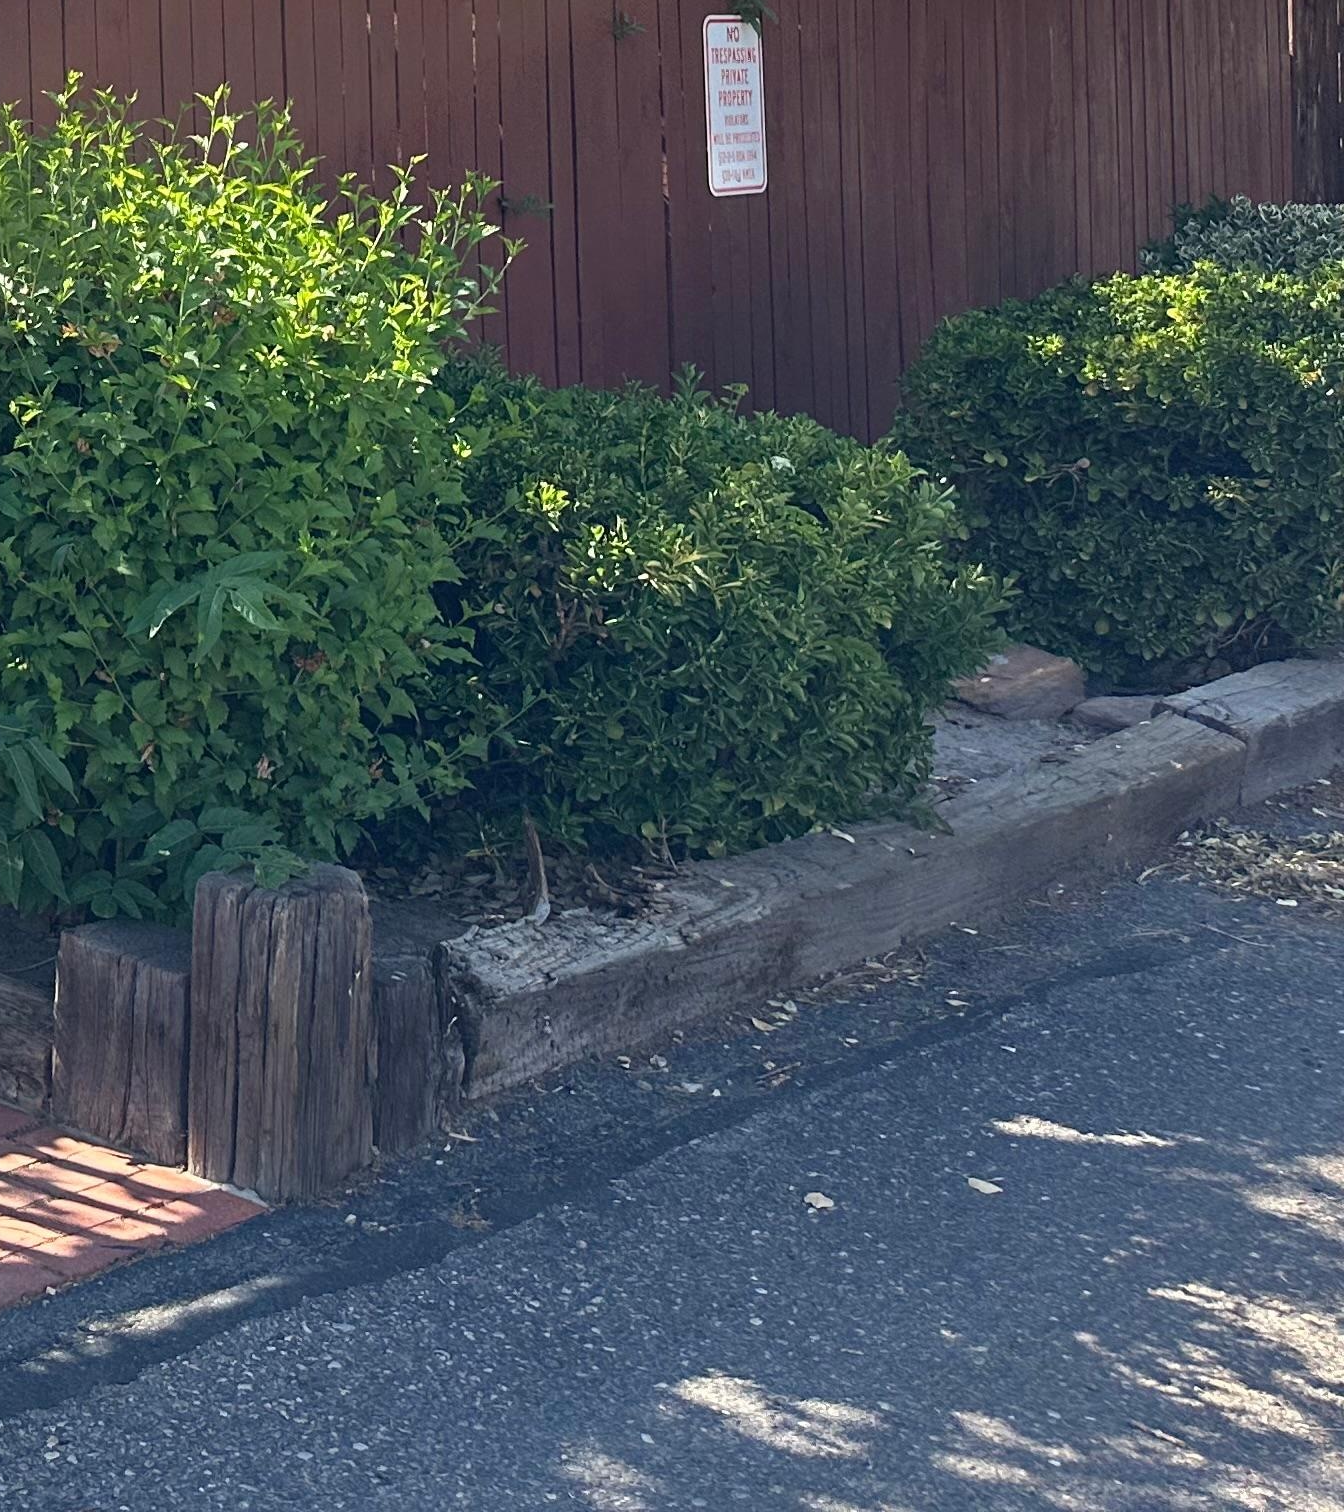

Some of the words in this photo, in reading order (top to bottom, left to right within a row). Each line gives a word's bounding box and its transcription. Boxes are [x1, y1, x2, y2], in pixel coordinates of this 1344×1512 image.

[726, 26, 740, 43] NO
[711, 47, 757, 65] TRESPASSING
[721, 68, 749, 85] PRIVATE
[718, 89, 753, 107] PROPERTY
